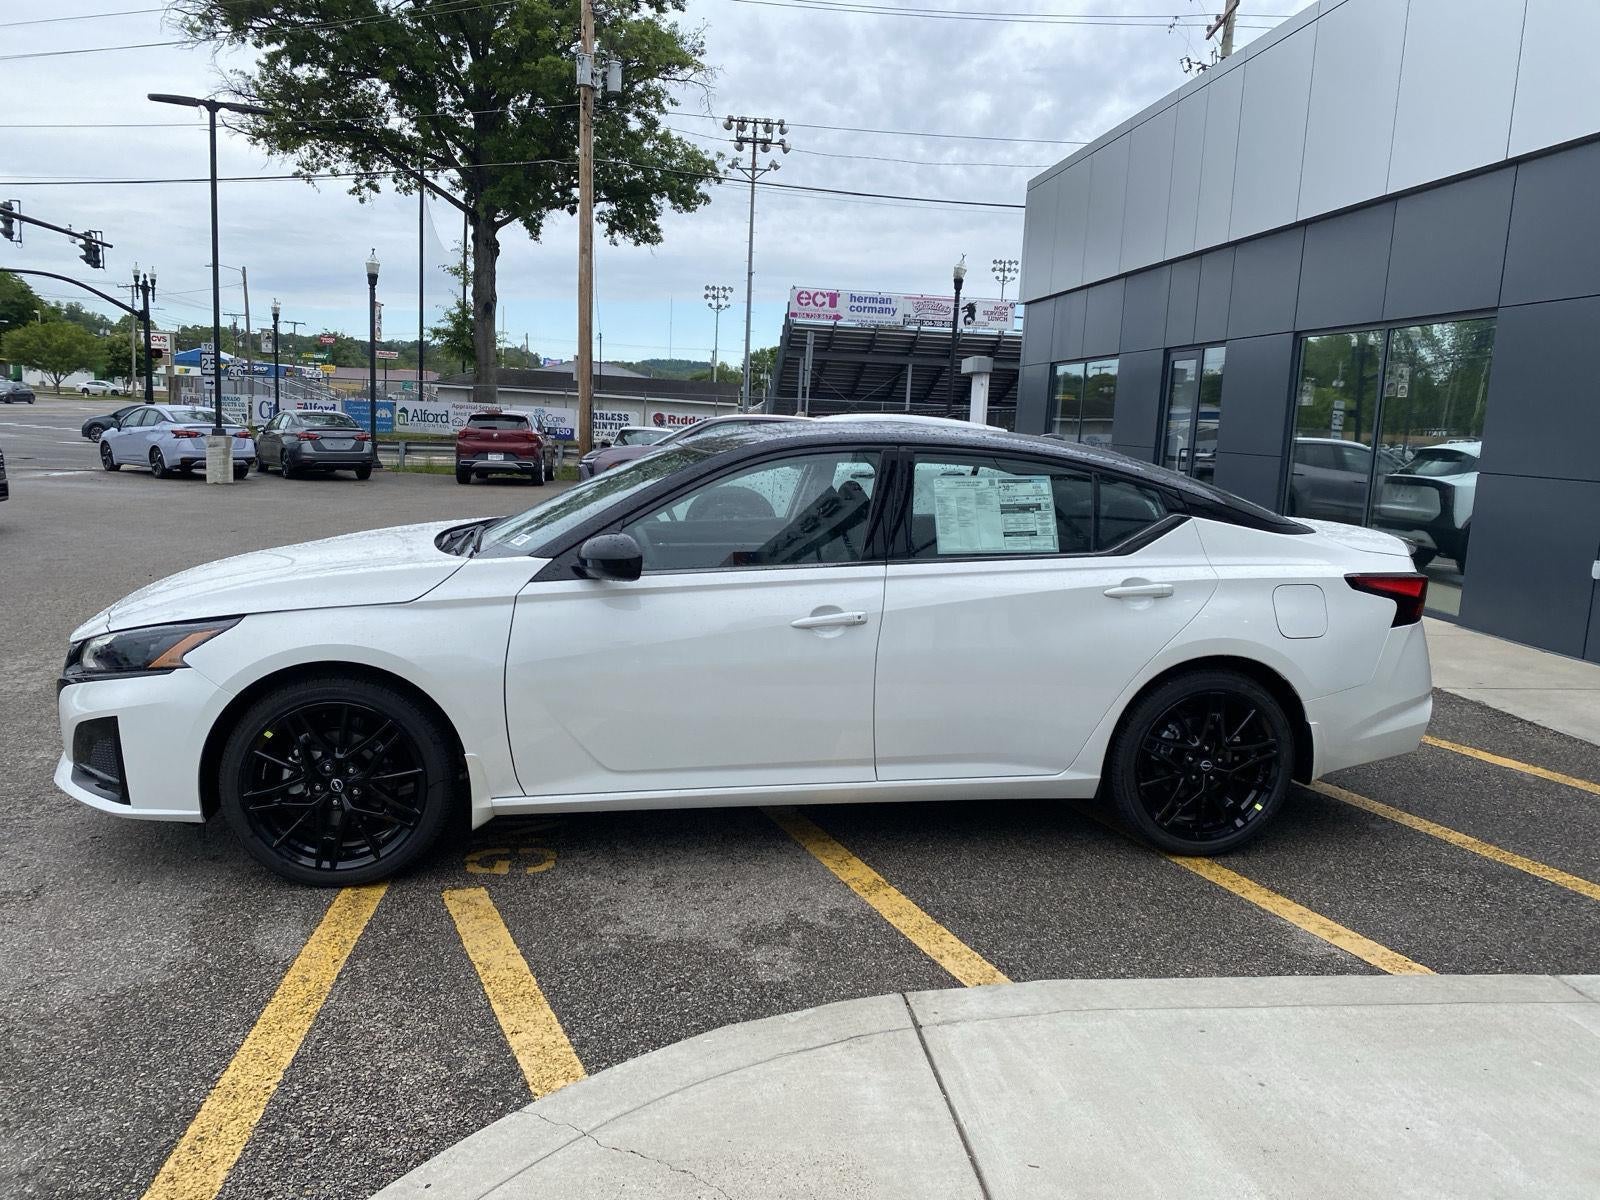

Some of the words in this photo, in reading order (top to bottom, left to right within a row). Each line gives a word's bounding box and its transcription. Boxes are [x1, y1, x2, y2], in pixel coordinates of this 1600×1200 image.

[849, 293, 892, 305] herman
[849, 304, 898, 317] cormany
[151, 335, 168, 343] CVS
[203, 343, 213, 351] TO
[202, 358, 216, 371] 25
[229, 368, 243, 377] 60
[451, 402, 478, 411] Appraisal
[410, 408, 450, 424] Alford
[545, 413, 567, 424] Care
[592, 412, 630, 422] ARLESS
